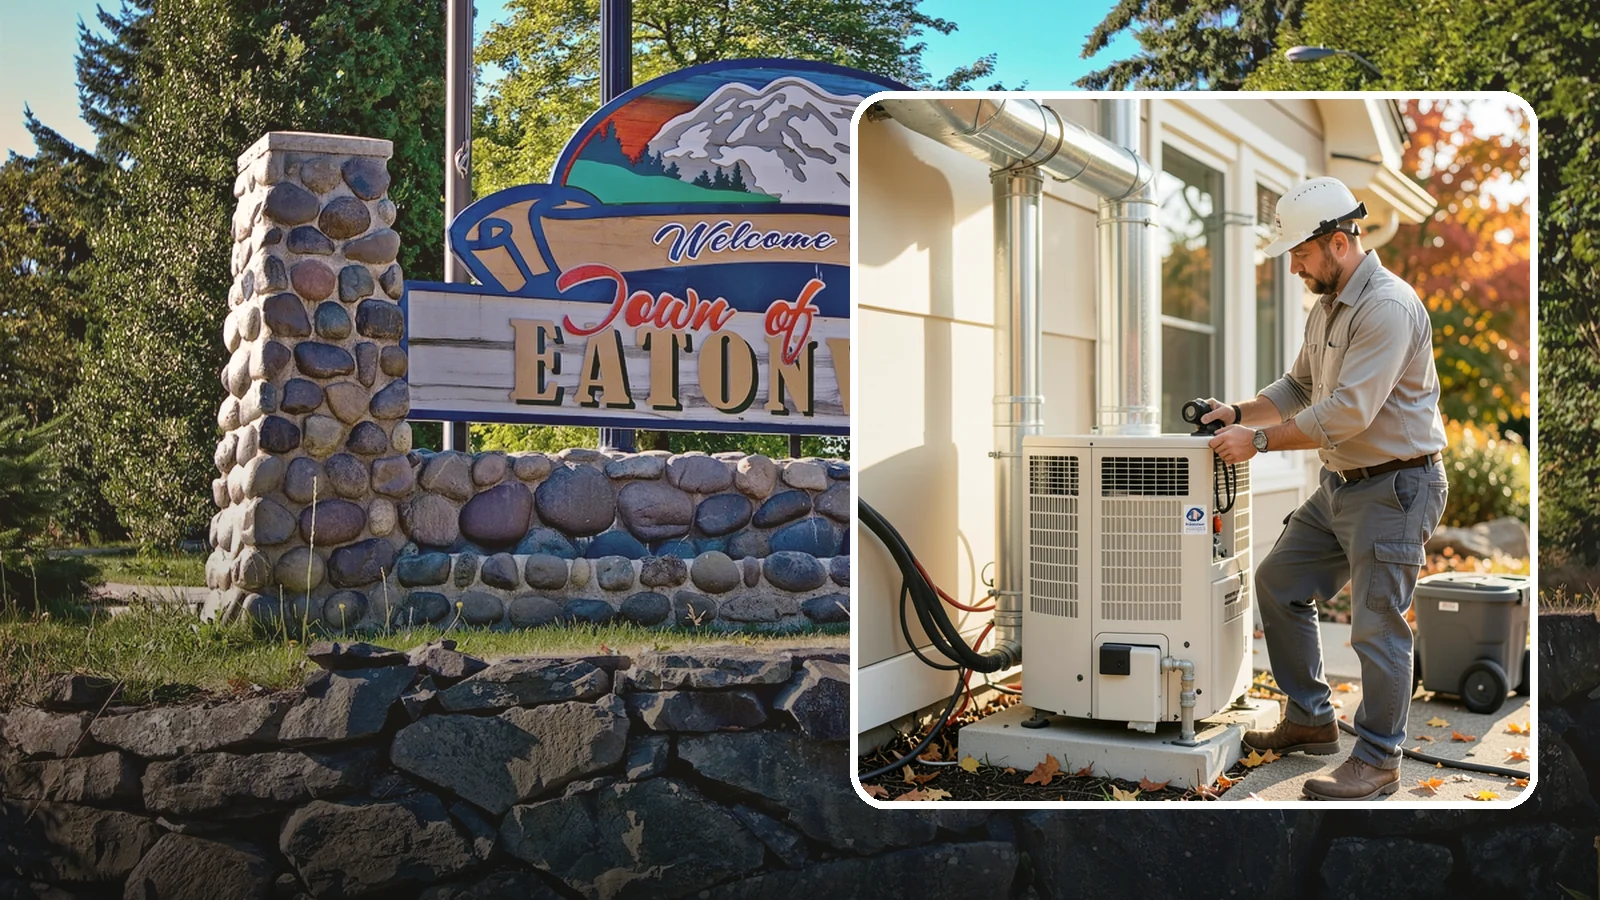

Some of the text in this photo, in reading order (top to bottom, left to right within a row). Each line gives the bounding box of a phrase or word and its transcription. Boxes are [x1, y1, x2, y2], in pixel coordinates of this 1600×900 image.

[653, 220, 837, 264] Welcome
[556, 263, 826, 365] Town of
